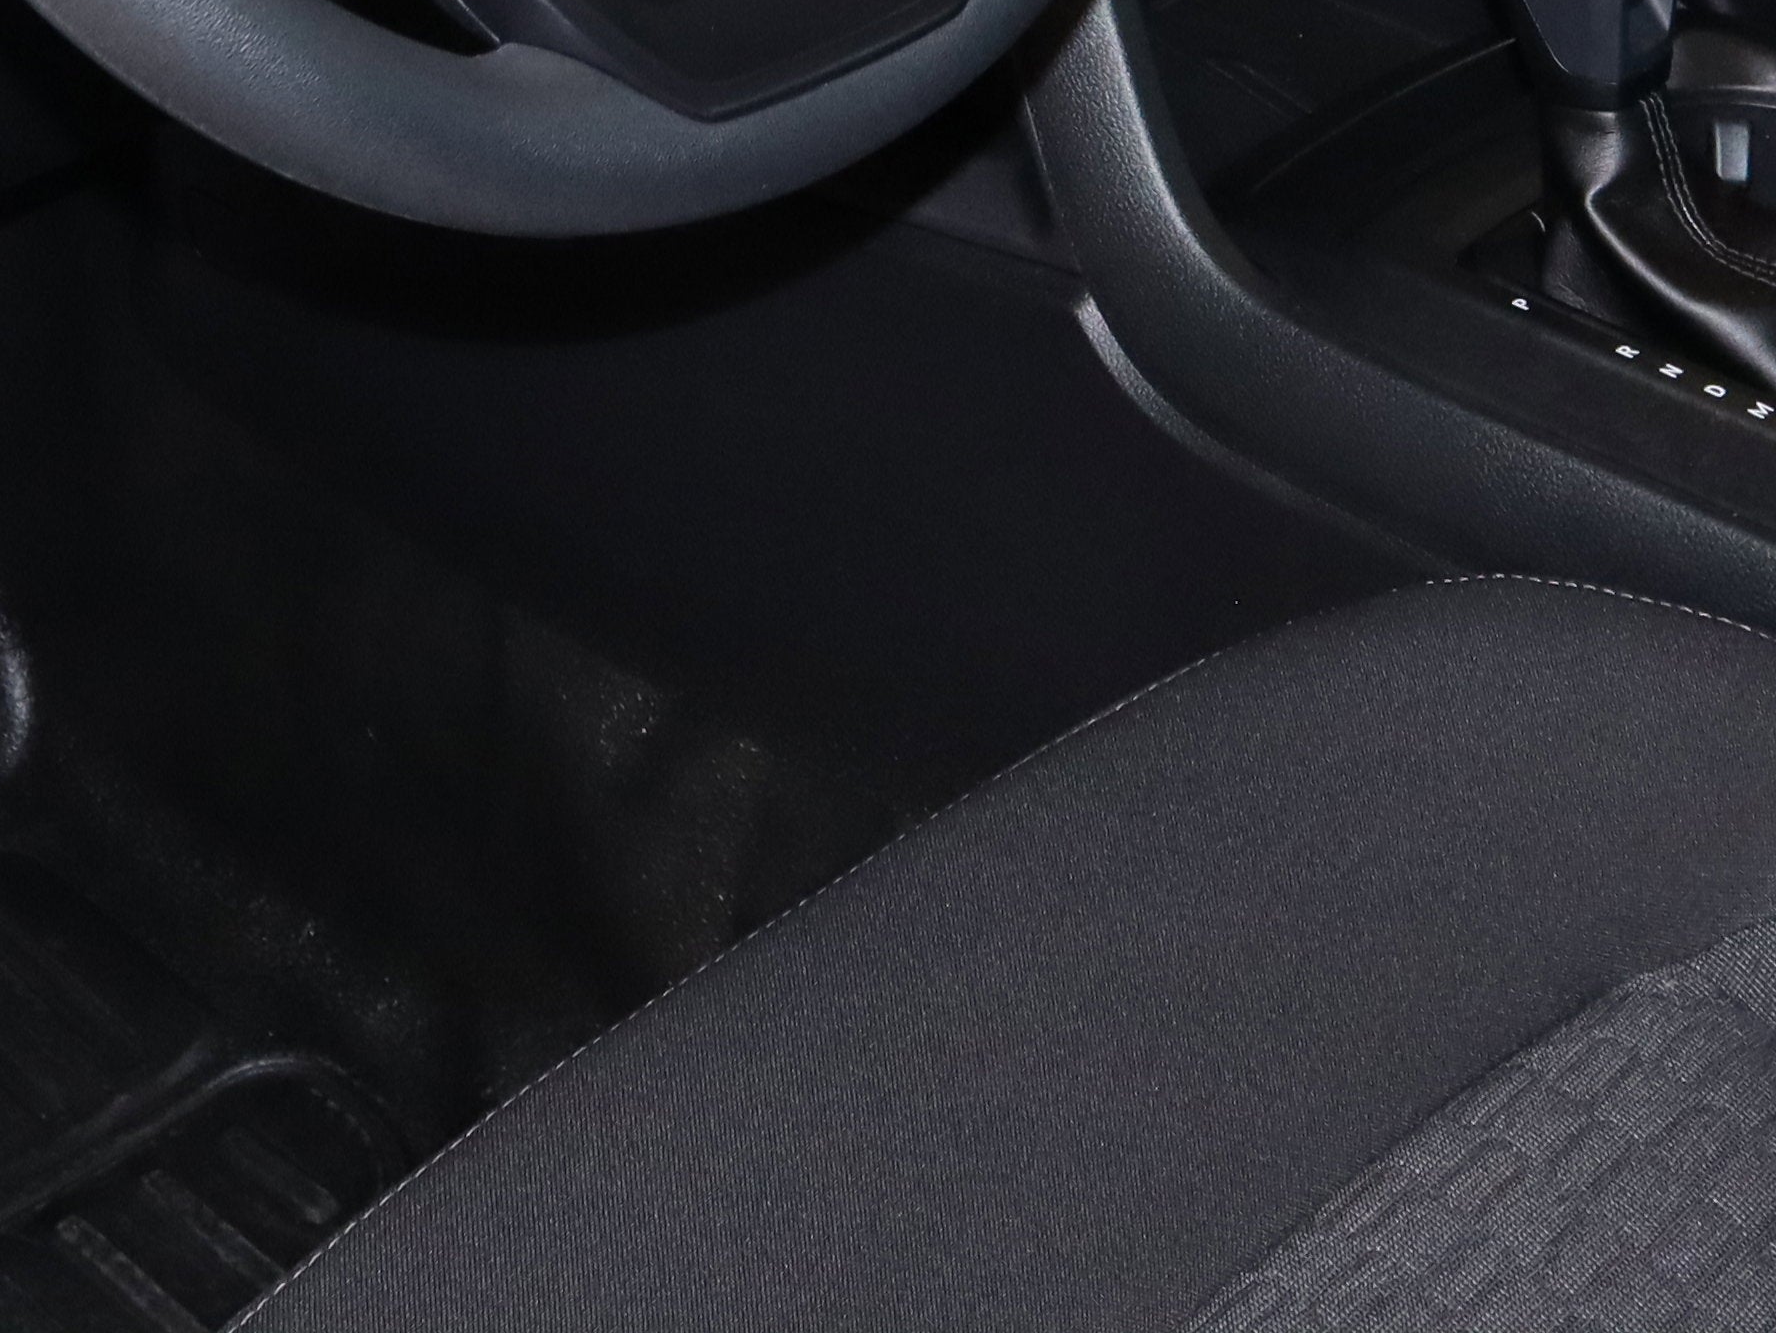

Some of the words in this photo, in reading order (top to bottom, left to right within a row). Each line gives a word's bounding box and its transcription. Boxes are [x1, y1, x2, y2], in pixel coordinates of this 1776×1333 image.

[1511, 298, 1530, 311] P
[1615, 344, 1640, 359] R
[1659, 363, 1684, 379] N
[1703, 384, 1727, 398] D
[1747, 401, 1774, 420] M
